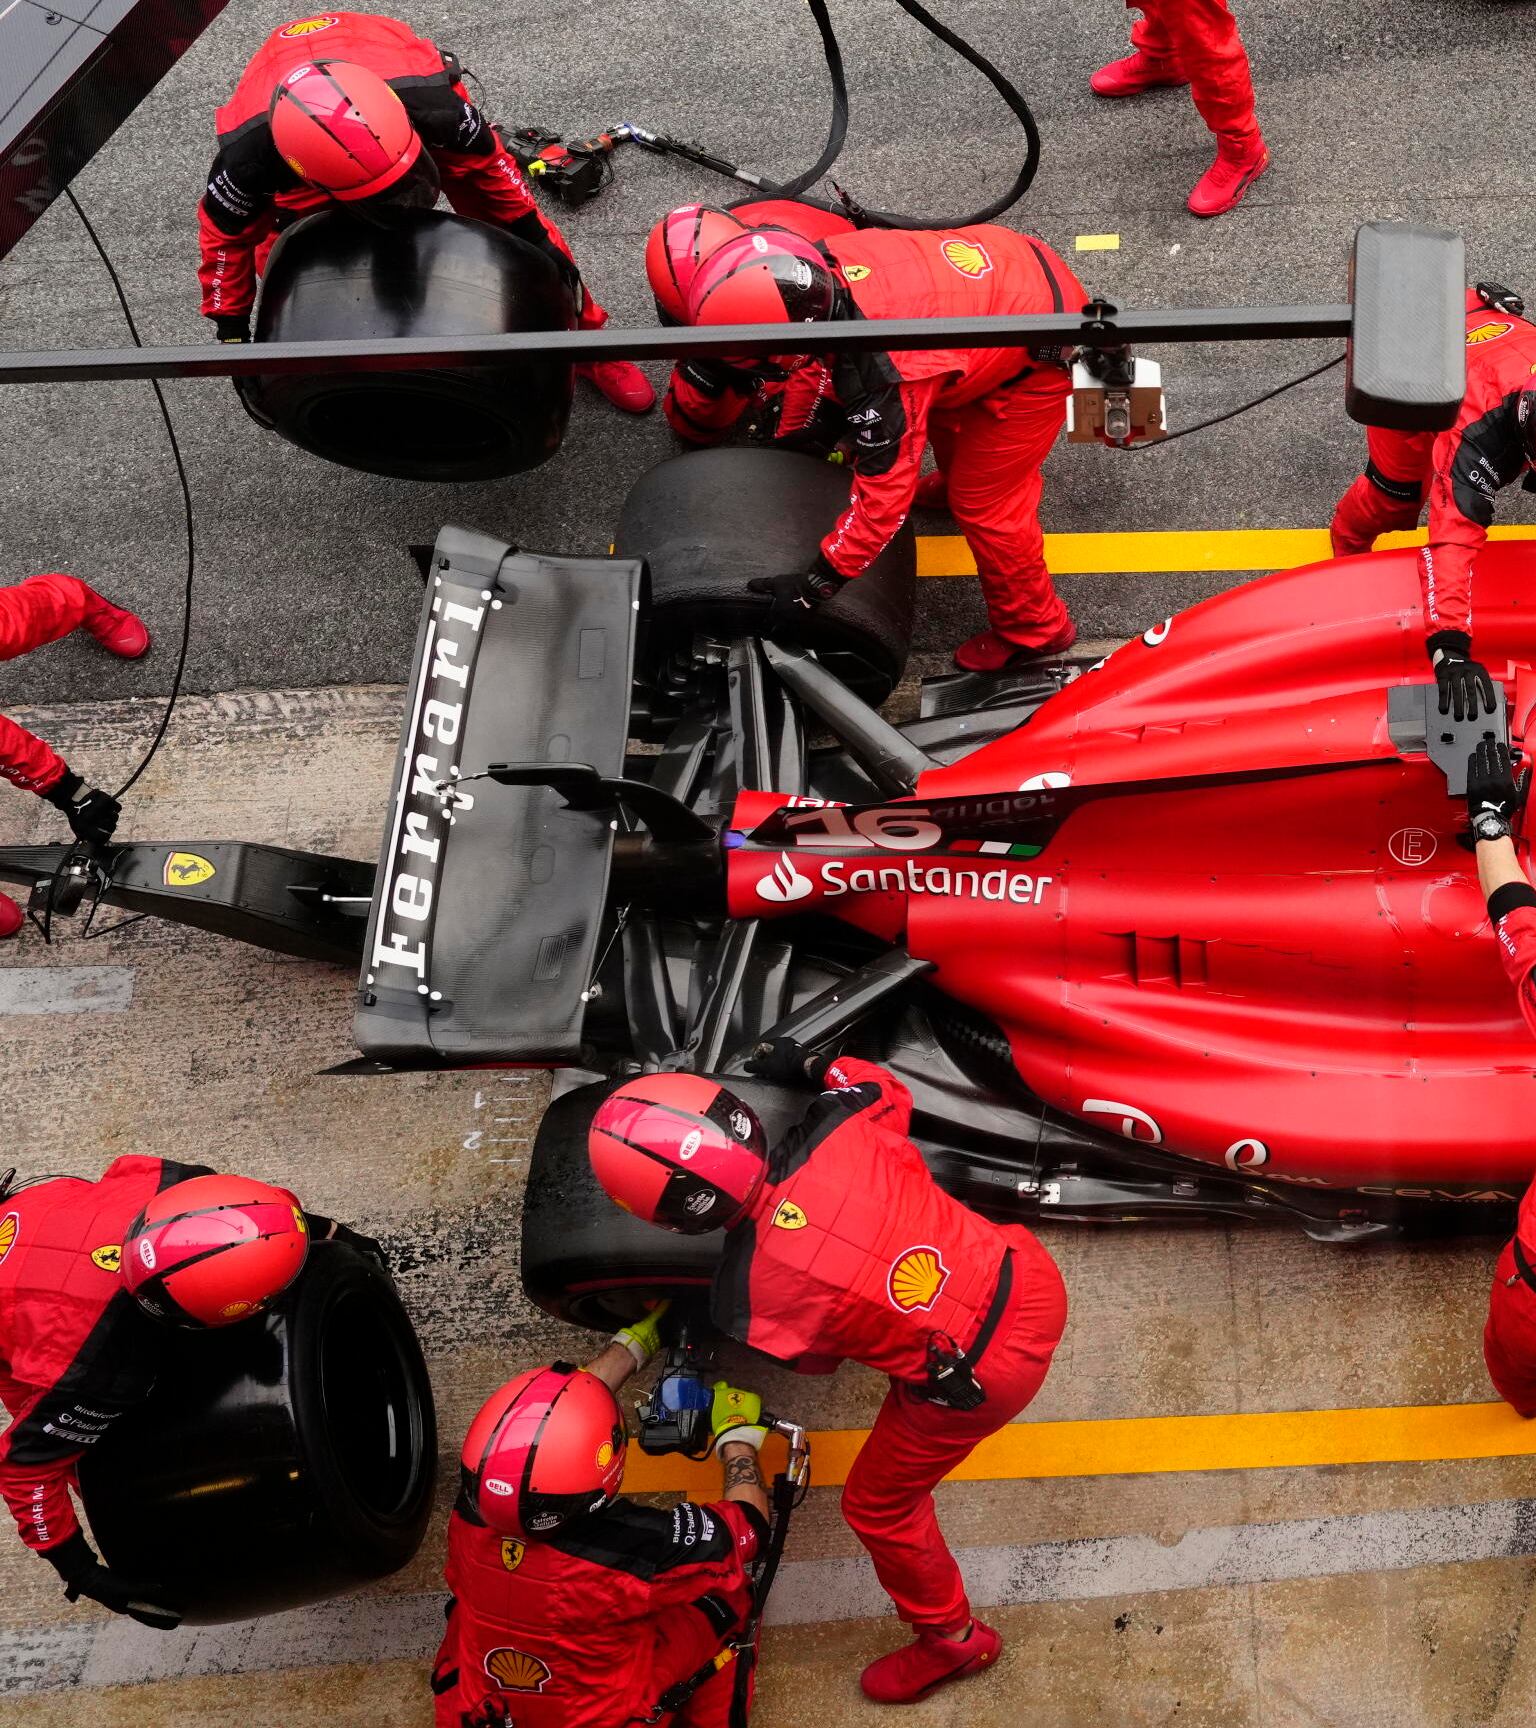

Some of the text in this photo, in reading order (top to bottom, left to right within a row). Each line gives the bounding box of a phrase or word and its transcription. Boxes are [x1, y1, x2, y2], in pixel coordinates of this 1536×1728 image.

[1421, 547, 1439, 622] RICHARD MILLE
[371, 596, 487, 979] Ferrari
[788, 808, 943, 850] 16
[819, 859, 1053, 905] Santander
[1497, 927, 1518, 957] MILLE
[142, 1242, 153, 1265] BELL
[488, 1481, 510, 1494] BELL
[32, 1502, 50, 1542] RICHAR
